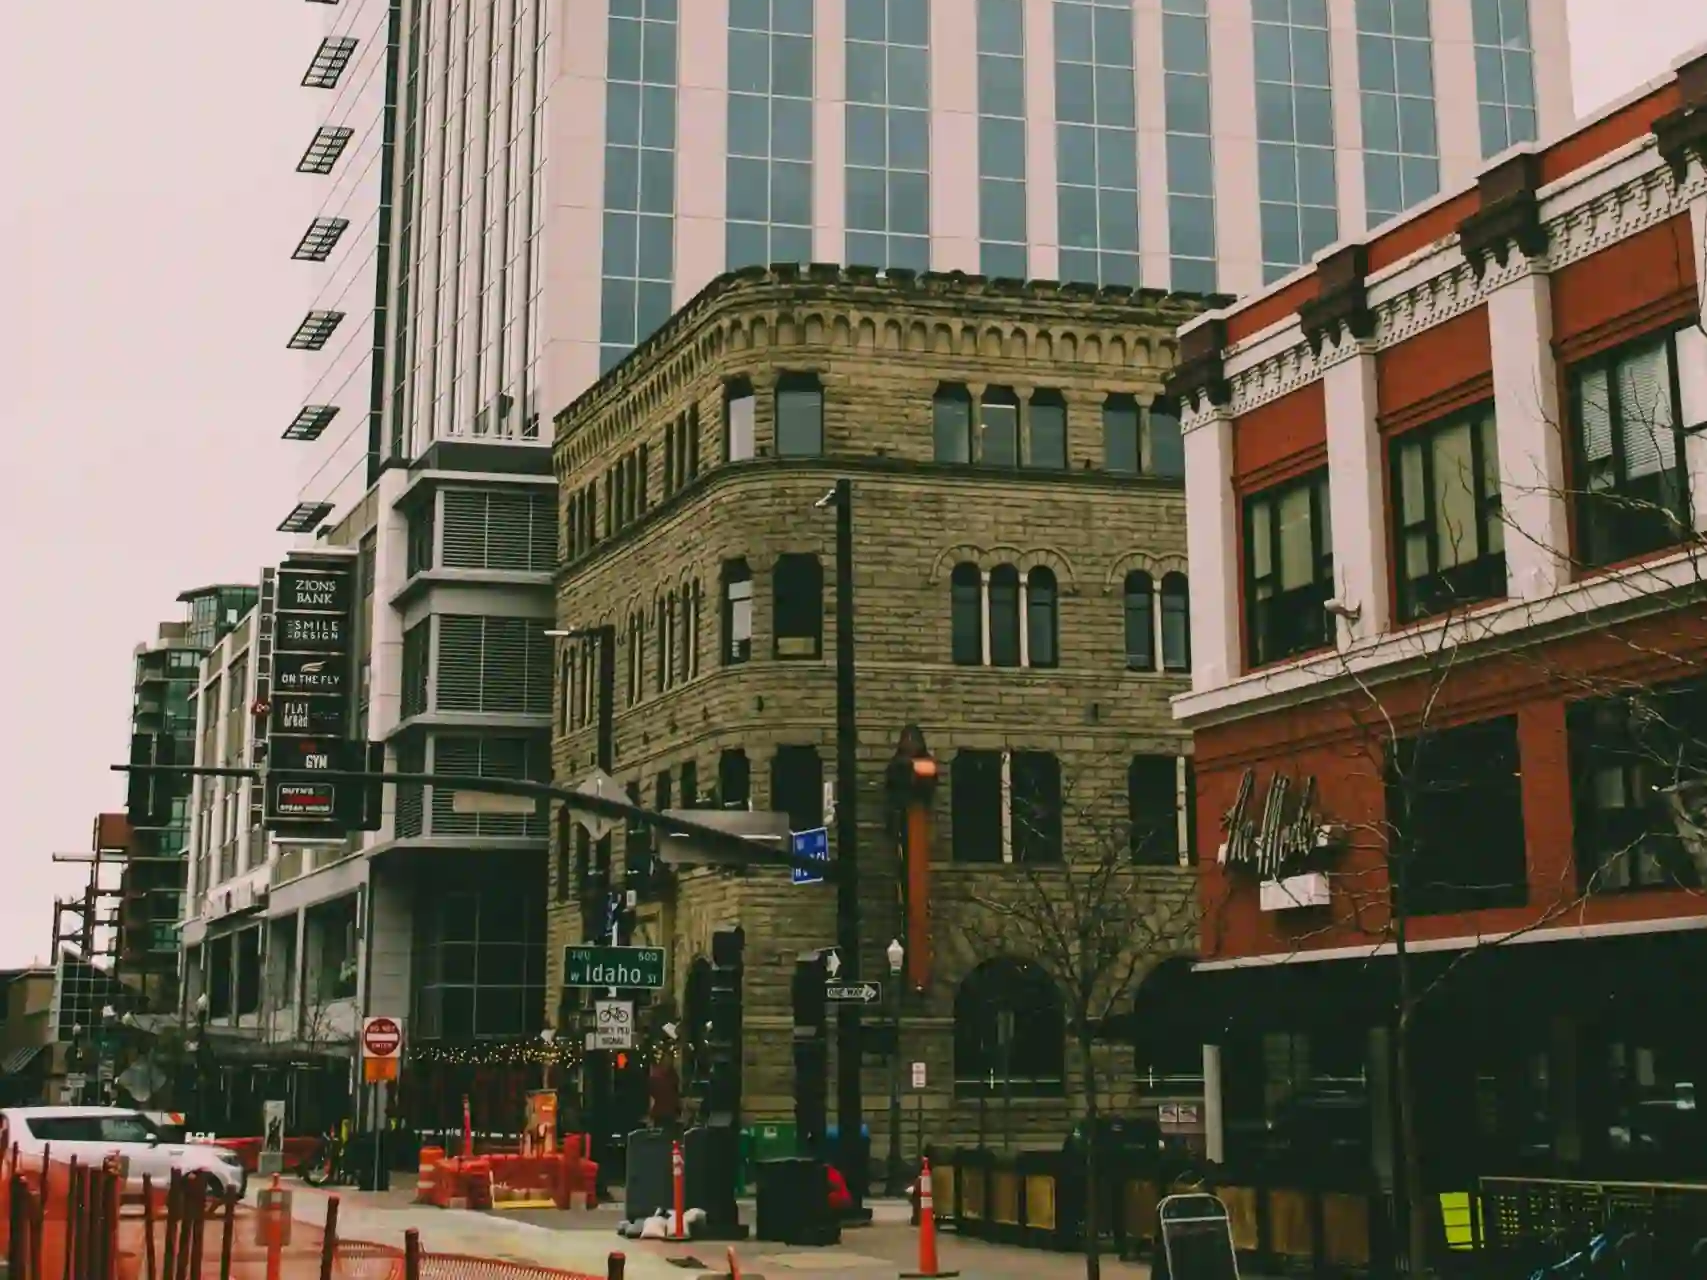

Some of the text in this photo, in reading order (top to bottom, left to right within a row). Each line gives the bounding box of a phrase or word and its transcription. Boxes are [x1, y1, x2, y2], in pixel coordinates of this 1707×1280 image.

[296, 592, 333, 604] BANK
[295, 620, 339, 631] SMILE
[294, 631, 339, 640] DESIGN
[281, 673, 341, 685] ON THE FLY
[305, 754, 328, 769] GYM
[570, 971, 580, 982] W
[586, 963, 641, 984] Idaho
